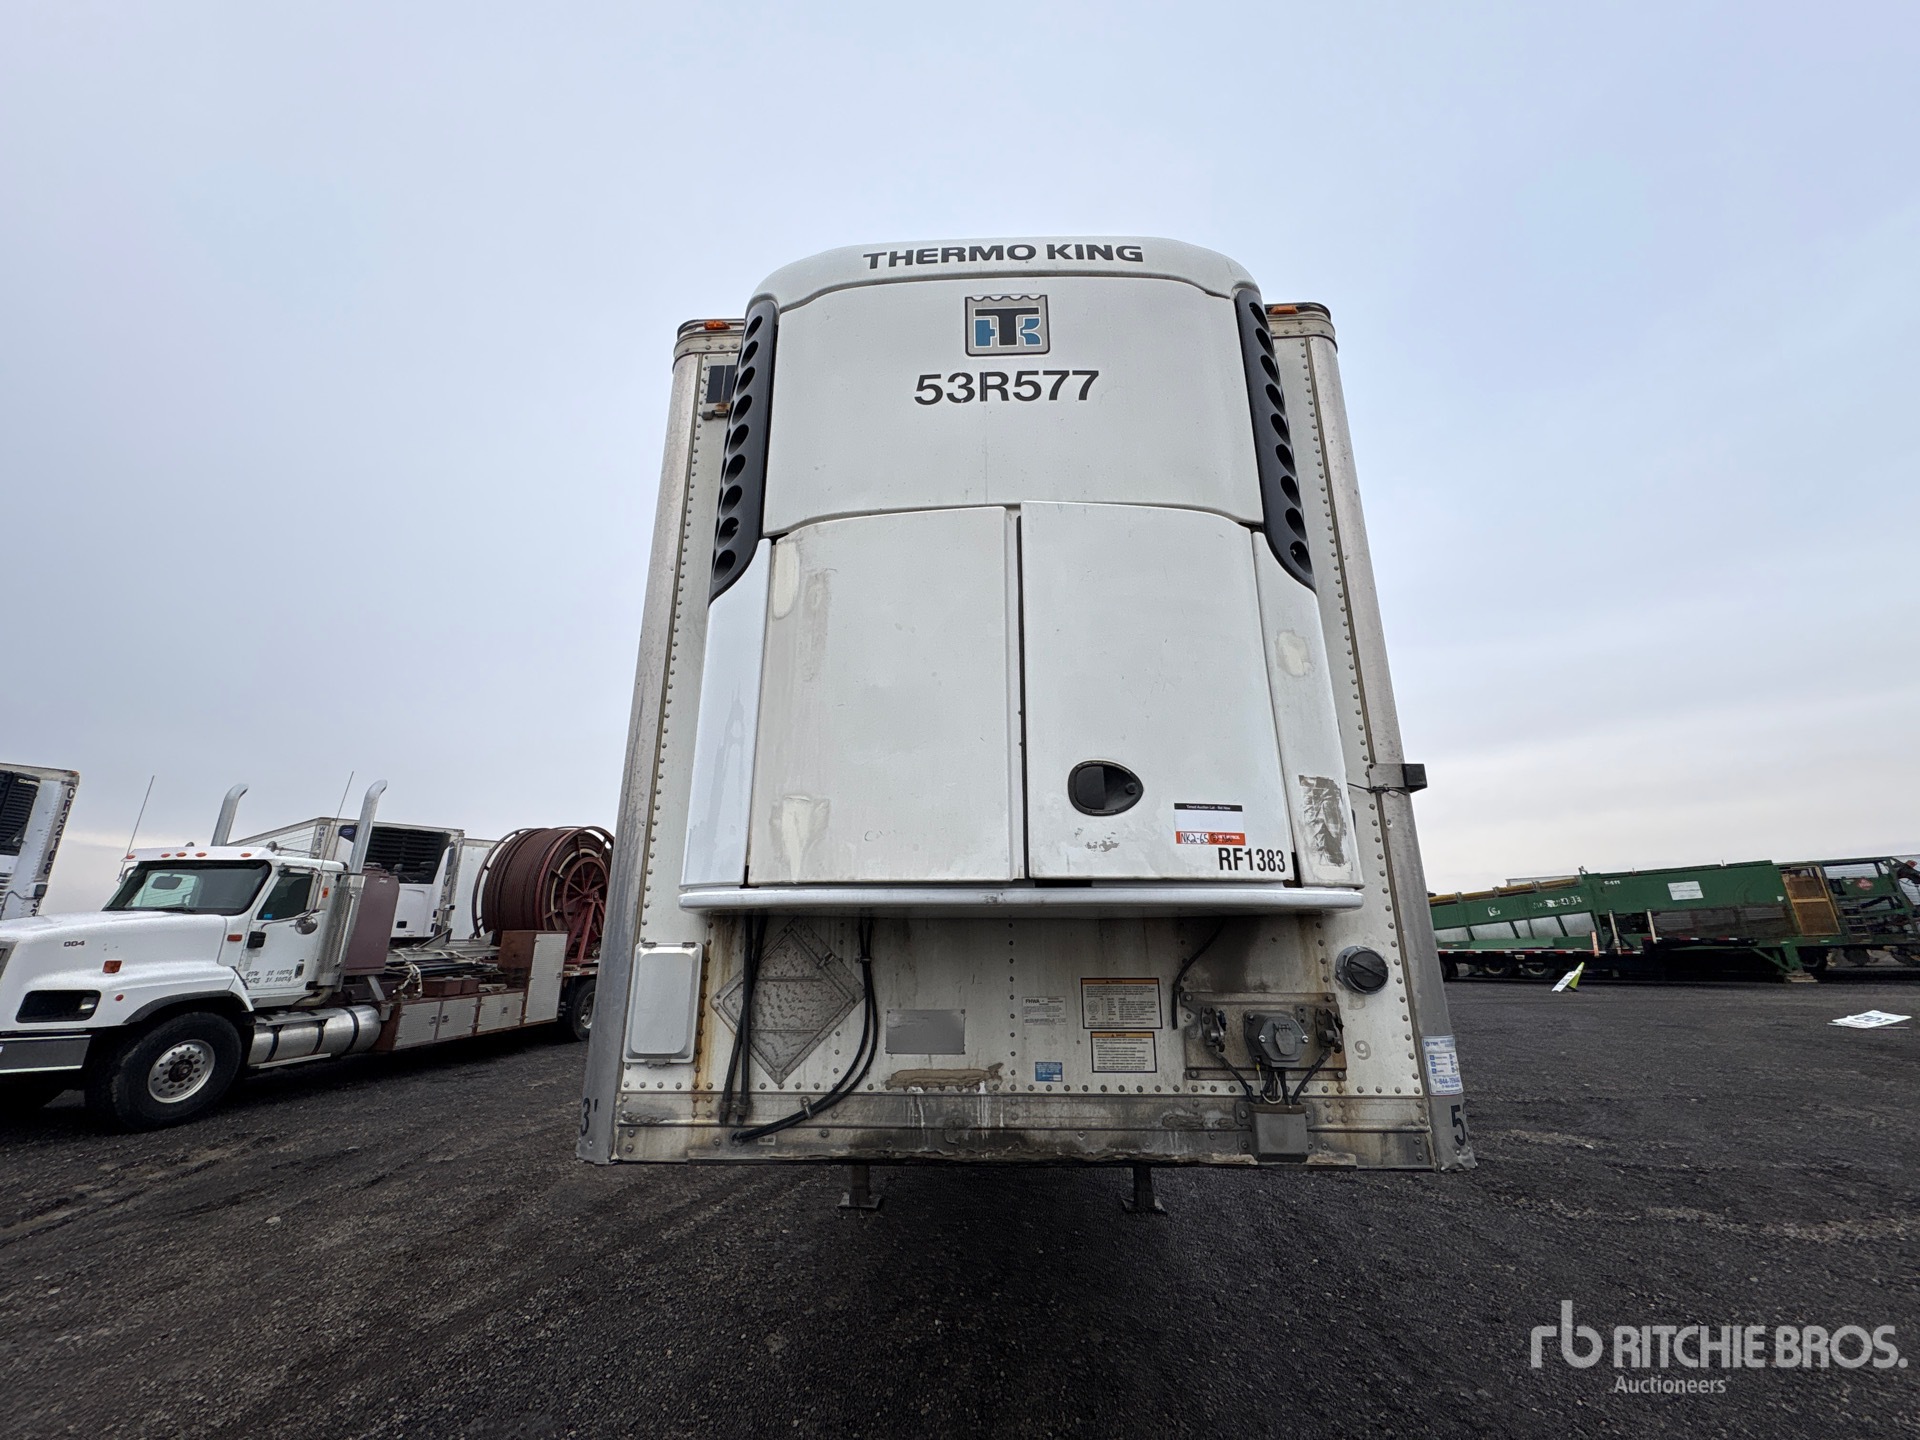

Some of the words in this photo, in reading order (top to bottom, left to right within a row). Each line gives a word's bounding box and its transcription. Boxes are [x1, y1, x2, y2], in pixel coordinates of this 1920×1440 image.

[863, 244, 1037, 270] THERMO
[1046, 243, 1144, 262] KING
[914, 370, 1099, 405] 53R577
[1218, 848, 1286, 873] RF1383
[1450, 1104, 1469, 1147] 5
